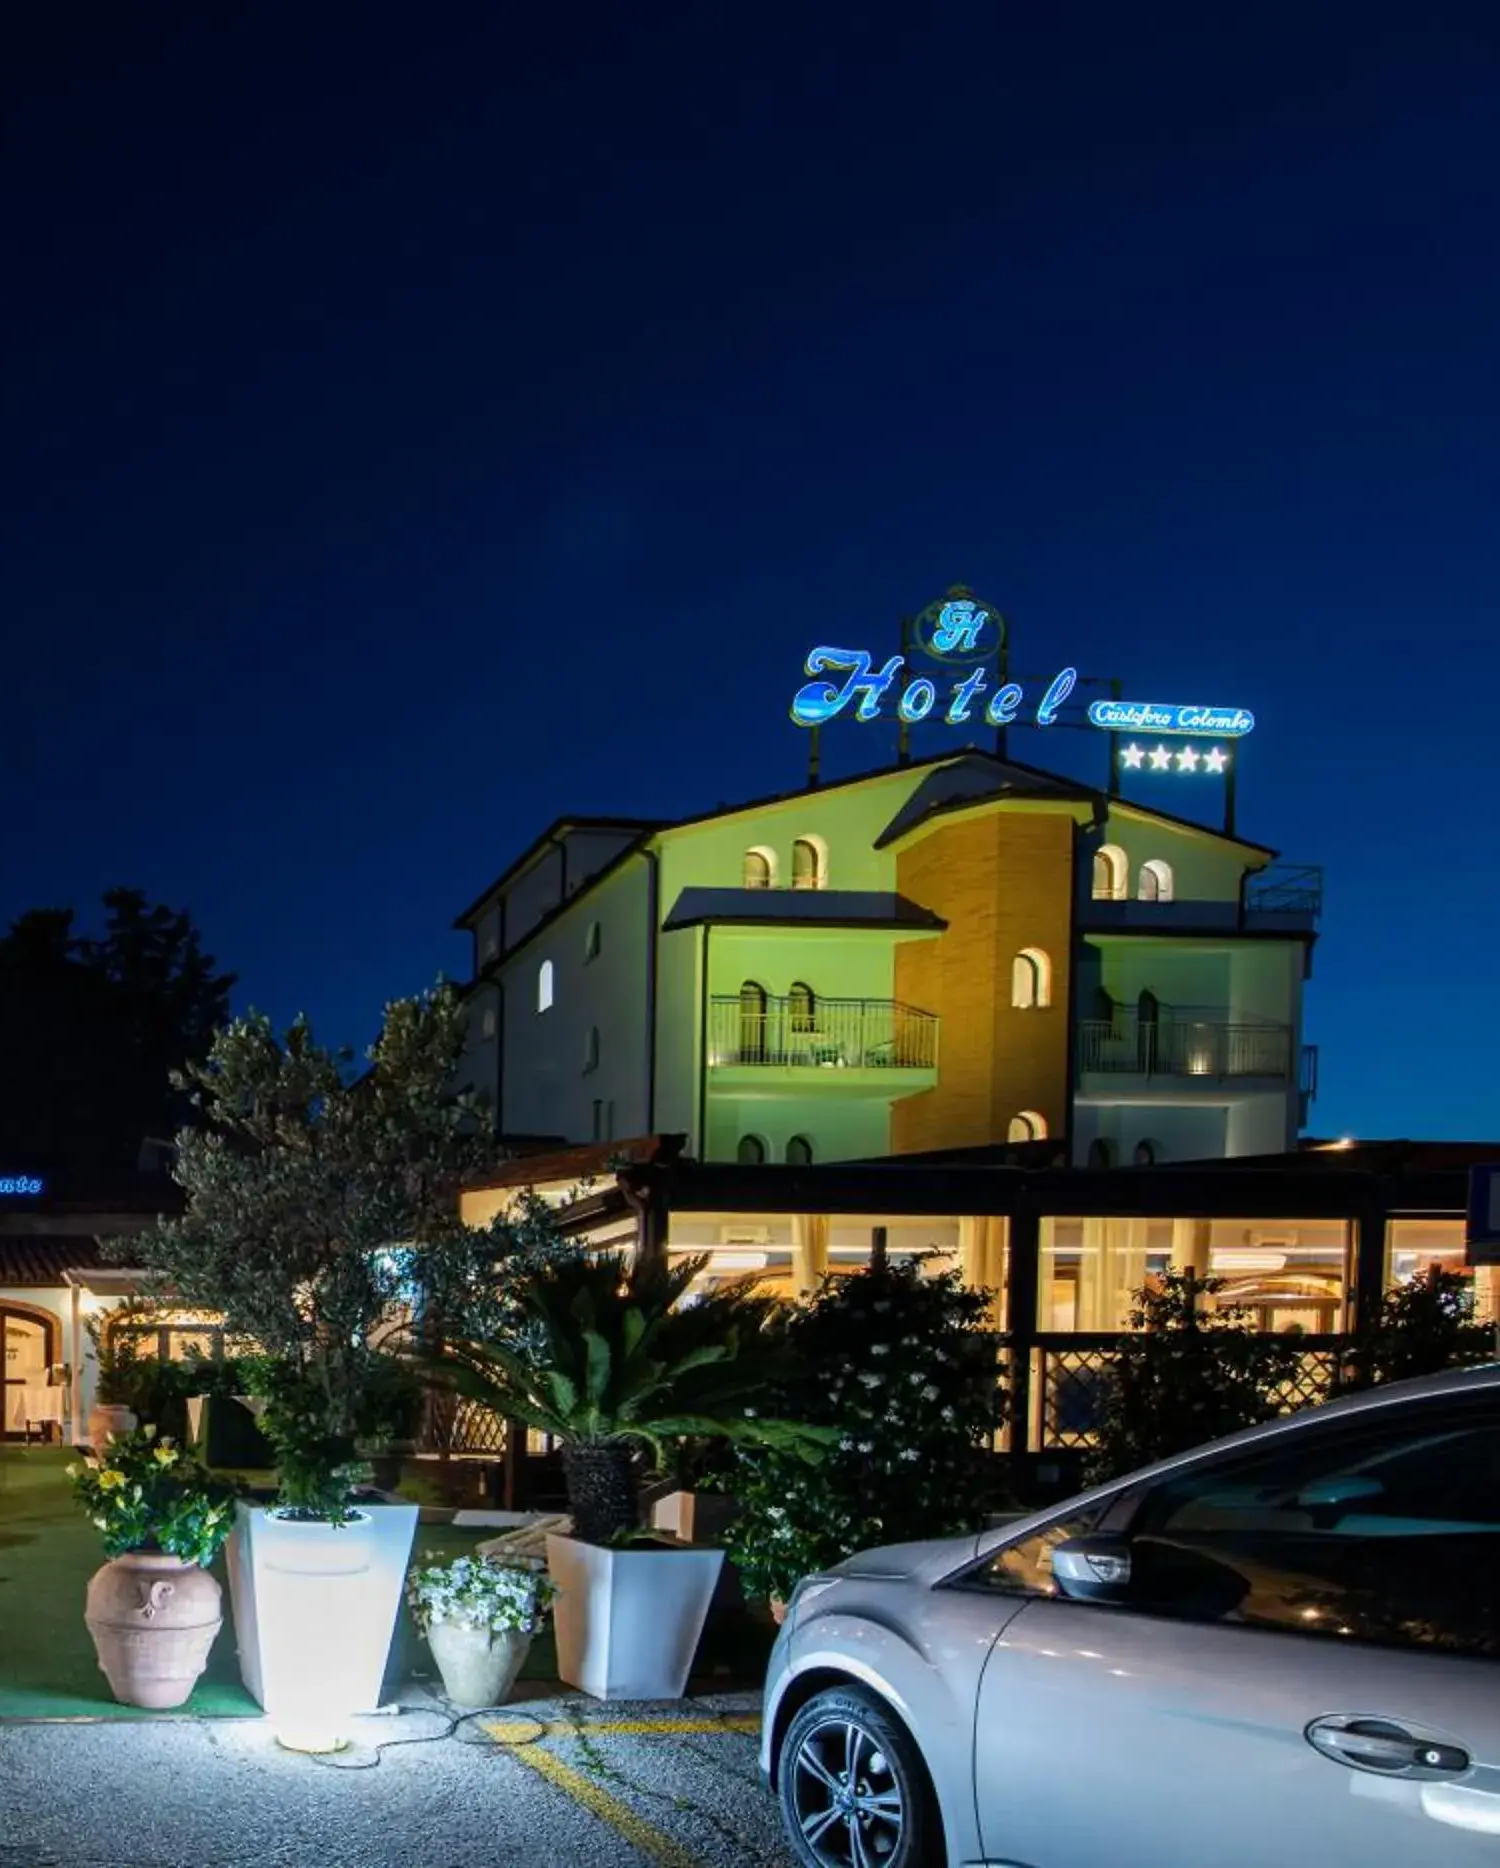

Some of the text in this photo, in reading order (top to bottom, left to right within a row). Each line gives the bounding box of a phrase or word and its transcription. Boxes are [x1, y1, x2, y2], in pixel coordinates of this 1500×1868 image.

[791, 646, 1077, 726] Hotel
[1095, 701, 1251, 730] Cristoforo Colombo
